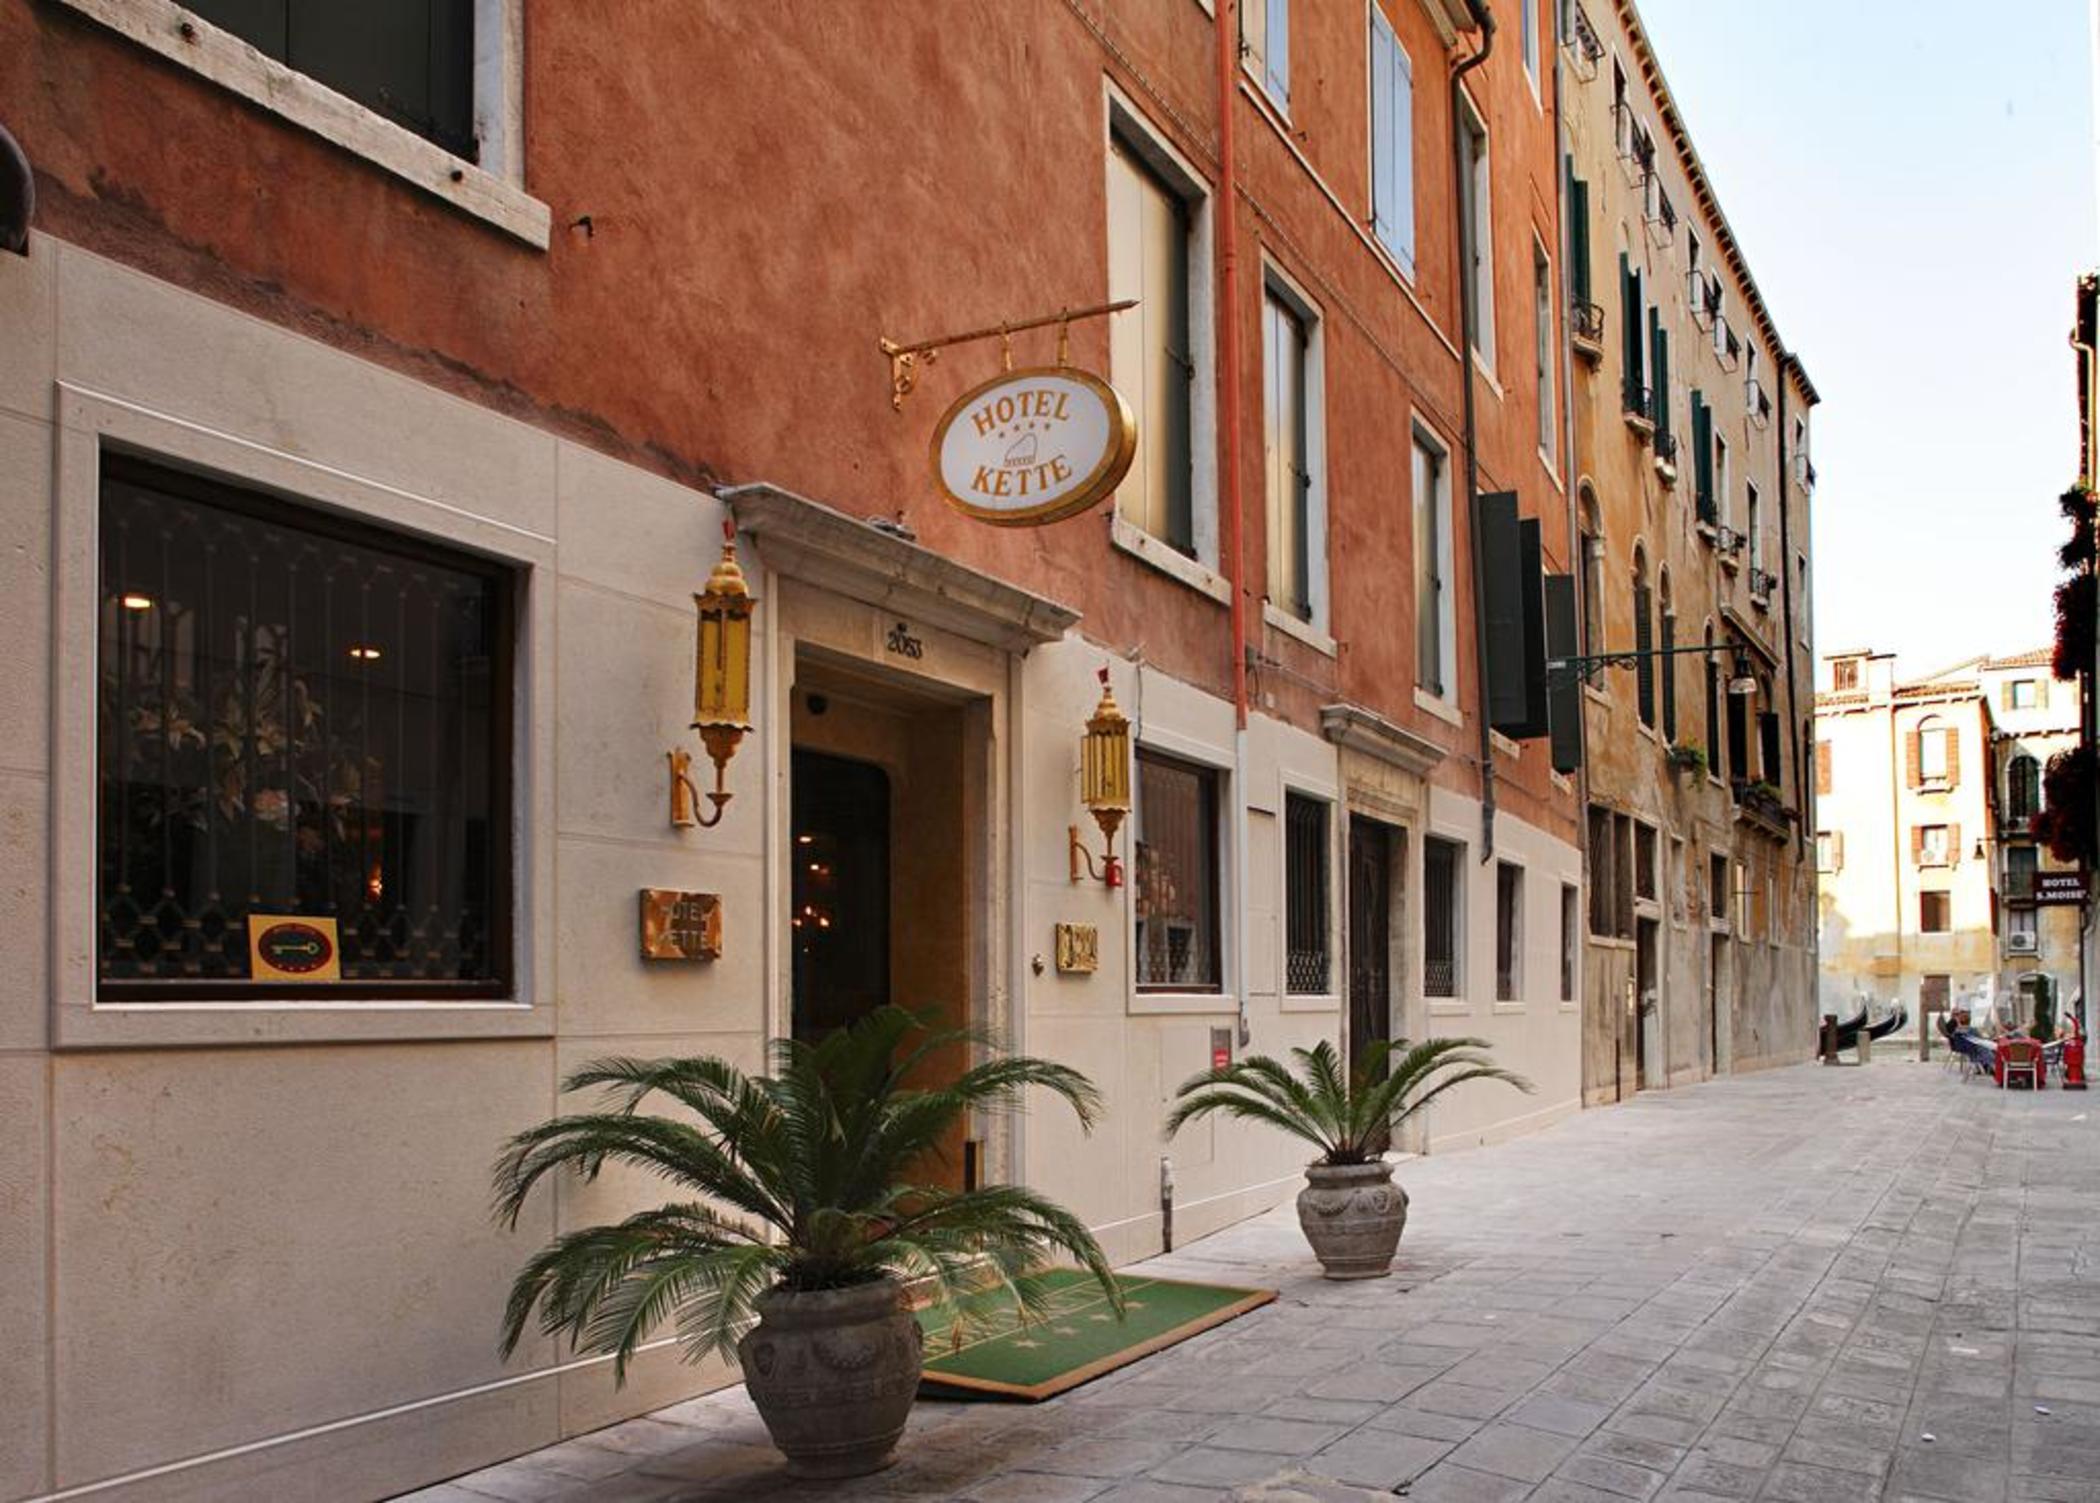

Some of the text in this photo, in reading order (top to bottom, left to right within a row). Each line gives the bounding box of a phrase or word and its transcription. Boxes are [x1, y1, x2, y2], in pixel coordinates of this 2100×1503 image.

[971, 390, 1070, 436] HOTEL
[971, 454, 1072, 496] KETTE
[887, 630, 923, 660] 2053
[2041, 878, 2081, 888] HOTEL
